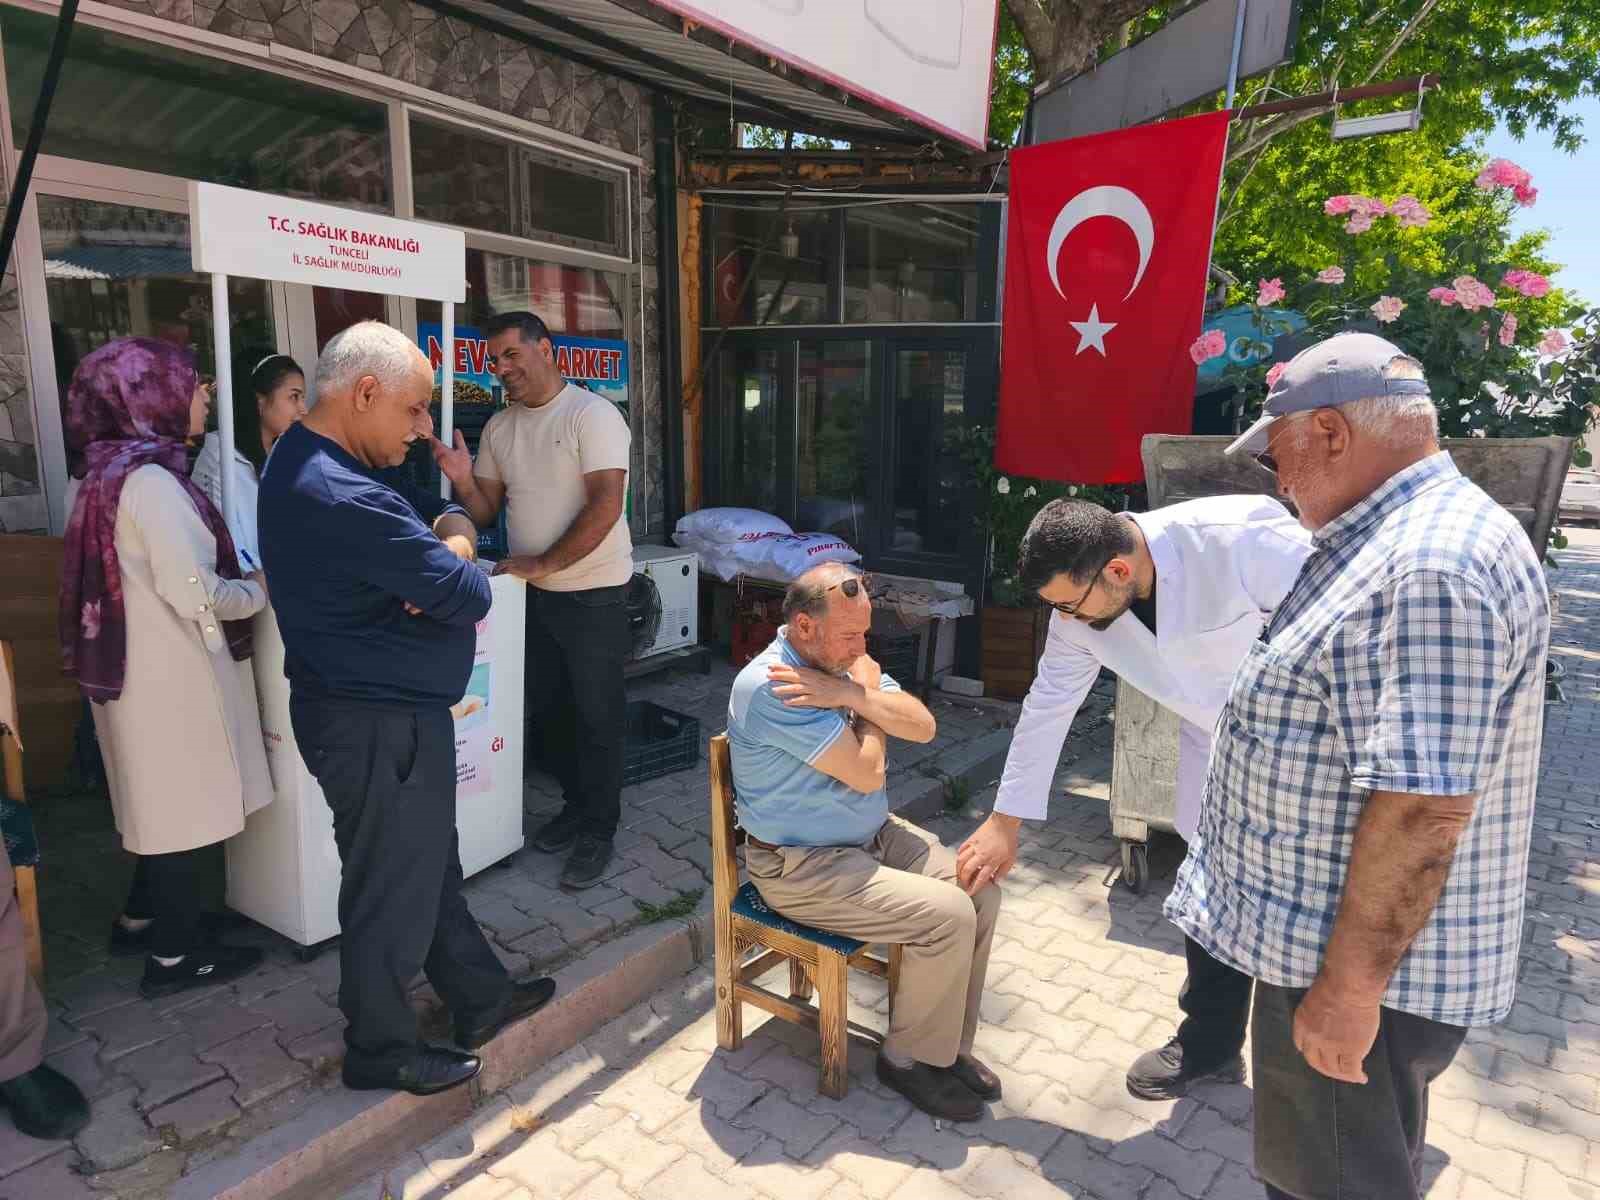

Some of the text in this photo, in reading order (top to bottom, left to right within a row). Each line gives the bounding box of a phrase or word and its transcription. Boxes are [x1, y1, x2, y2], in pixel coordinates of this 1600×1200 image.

[268, 215, 419, 253] T.C. SAĞLIK BAKANLIĞI
[304, 255, 339, 269] SAĞLIK
[328, 244, 369, 260] TUNCELİ
[556, 345, 622, 380] ARKET
